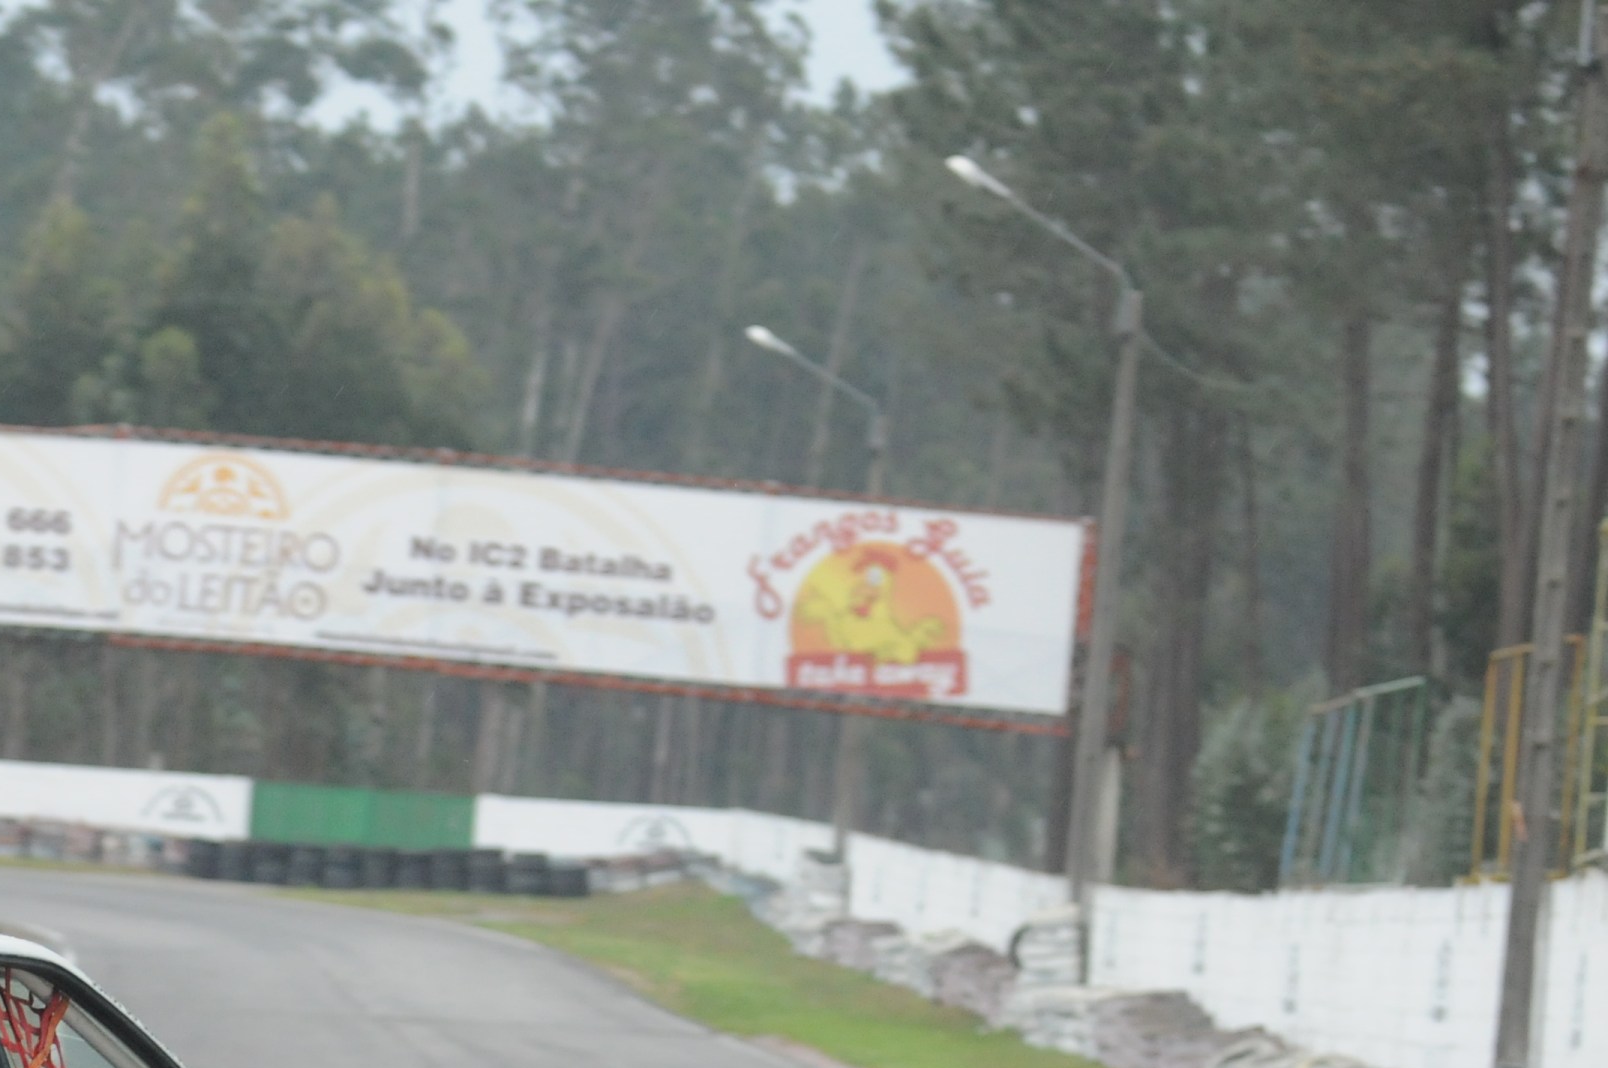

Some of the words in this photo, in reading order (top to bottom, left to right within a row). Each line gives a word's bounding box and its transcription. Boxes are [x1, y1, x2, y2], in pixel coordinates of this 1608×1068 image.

[6, 507, 72, 536] 666
[2, 544, 72, 572] 853
[112, 519, 340, 574] MOSTEIRO
[410, 537, 456, 564] No
[468, 541, 529, 570] IC2
[539, 546, 673, 582] Batalha
[362, 570, 470, 602] Junto
[482, 577, 505, 606] à
[520, 580, 717, 625] Exposalão
